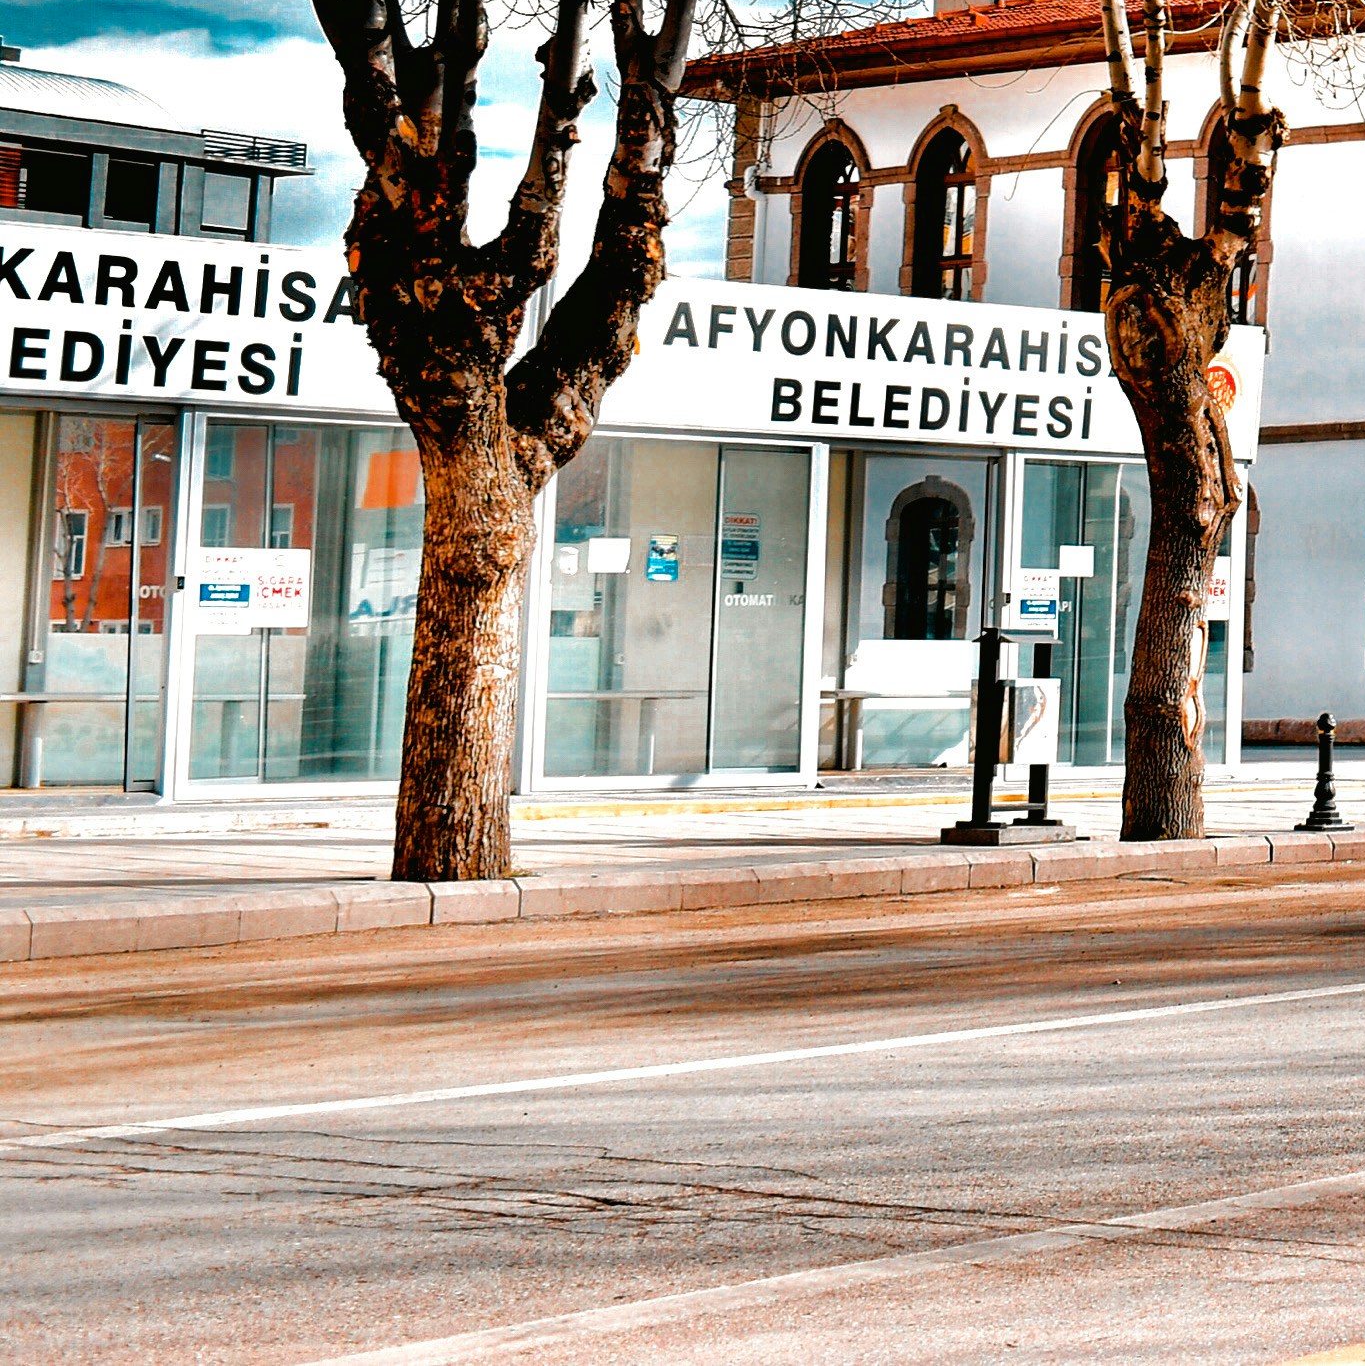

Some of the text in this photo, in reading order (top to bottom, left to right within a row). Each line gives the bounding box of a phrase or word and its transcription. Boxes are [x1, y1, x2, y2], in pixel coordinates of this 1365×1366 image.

[0, 246, 368, 326] KARAHİSA
[663, 302, 1116, 377] AFYONKARAHİS
[771, 377, 1093, 440] BELEDİYESİ
